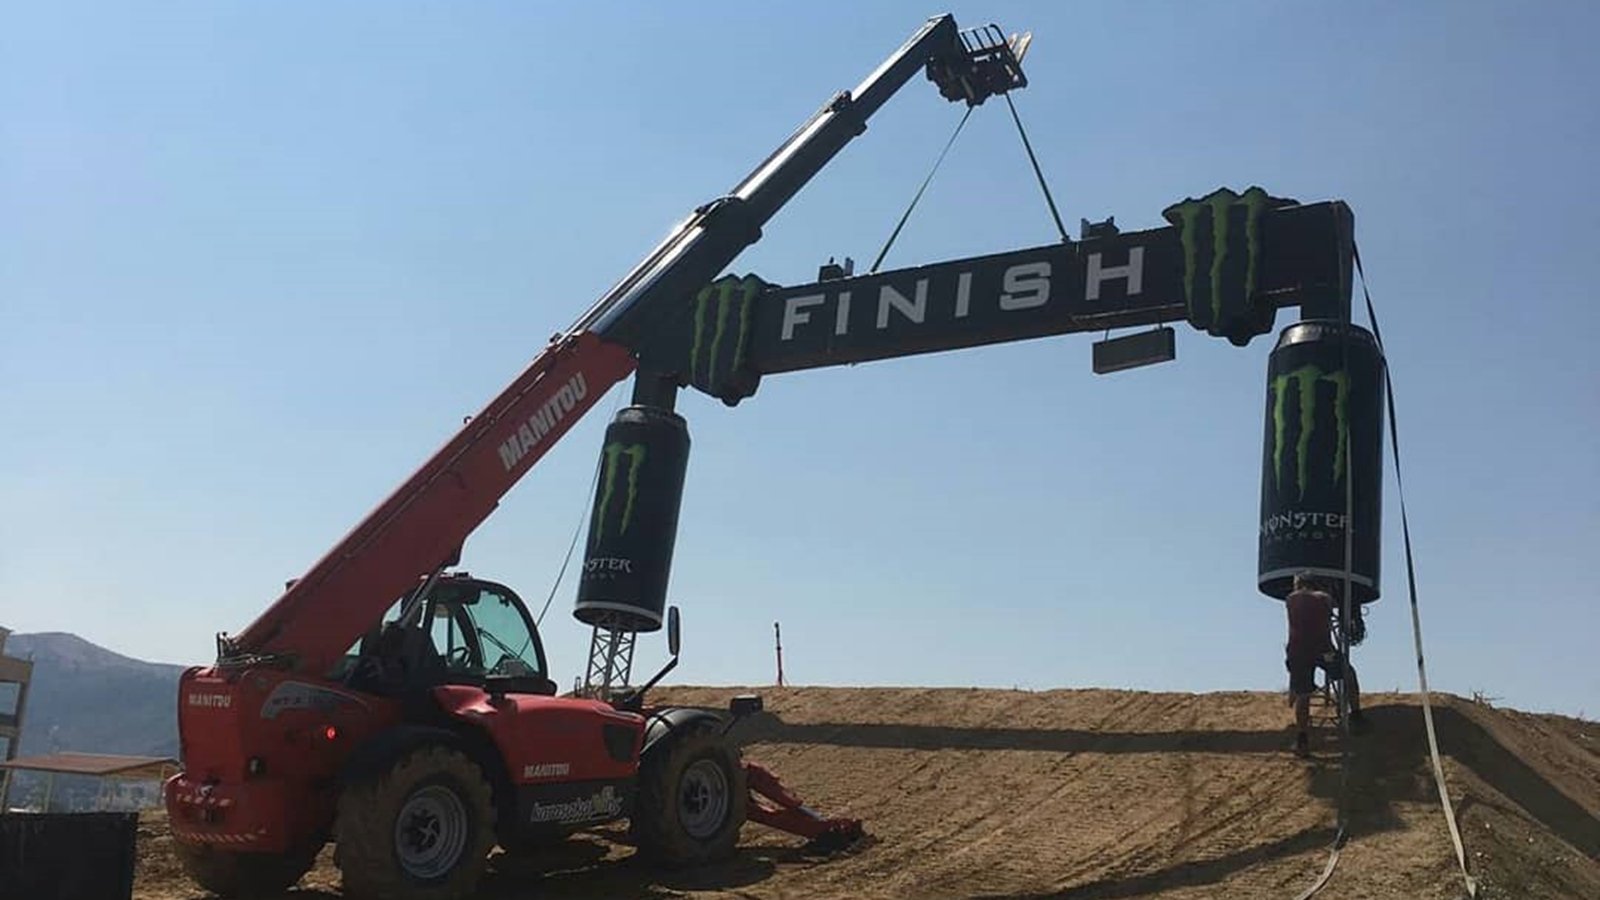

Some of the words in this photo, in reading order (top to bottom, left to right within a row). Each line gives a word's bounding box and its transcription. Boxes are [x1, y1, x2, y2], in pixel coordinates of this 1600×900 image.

[781, 246, 1145, 341] FINISH
[498, 370, 588, 472] MANITOU
[188, 694, 232, 708] MANITOU
